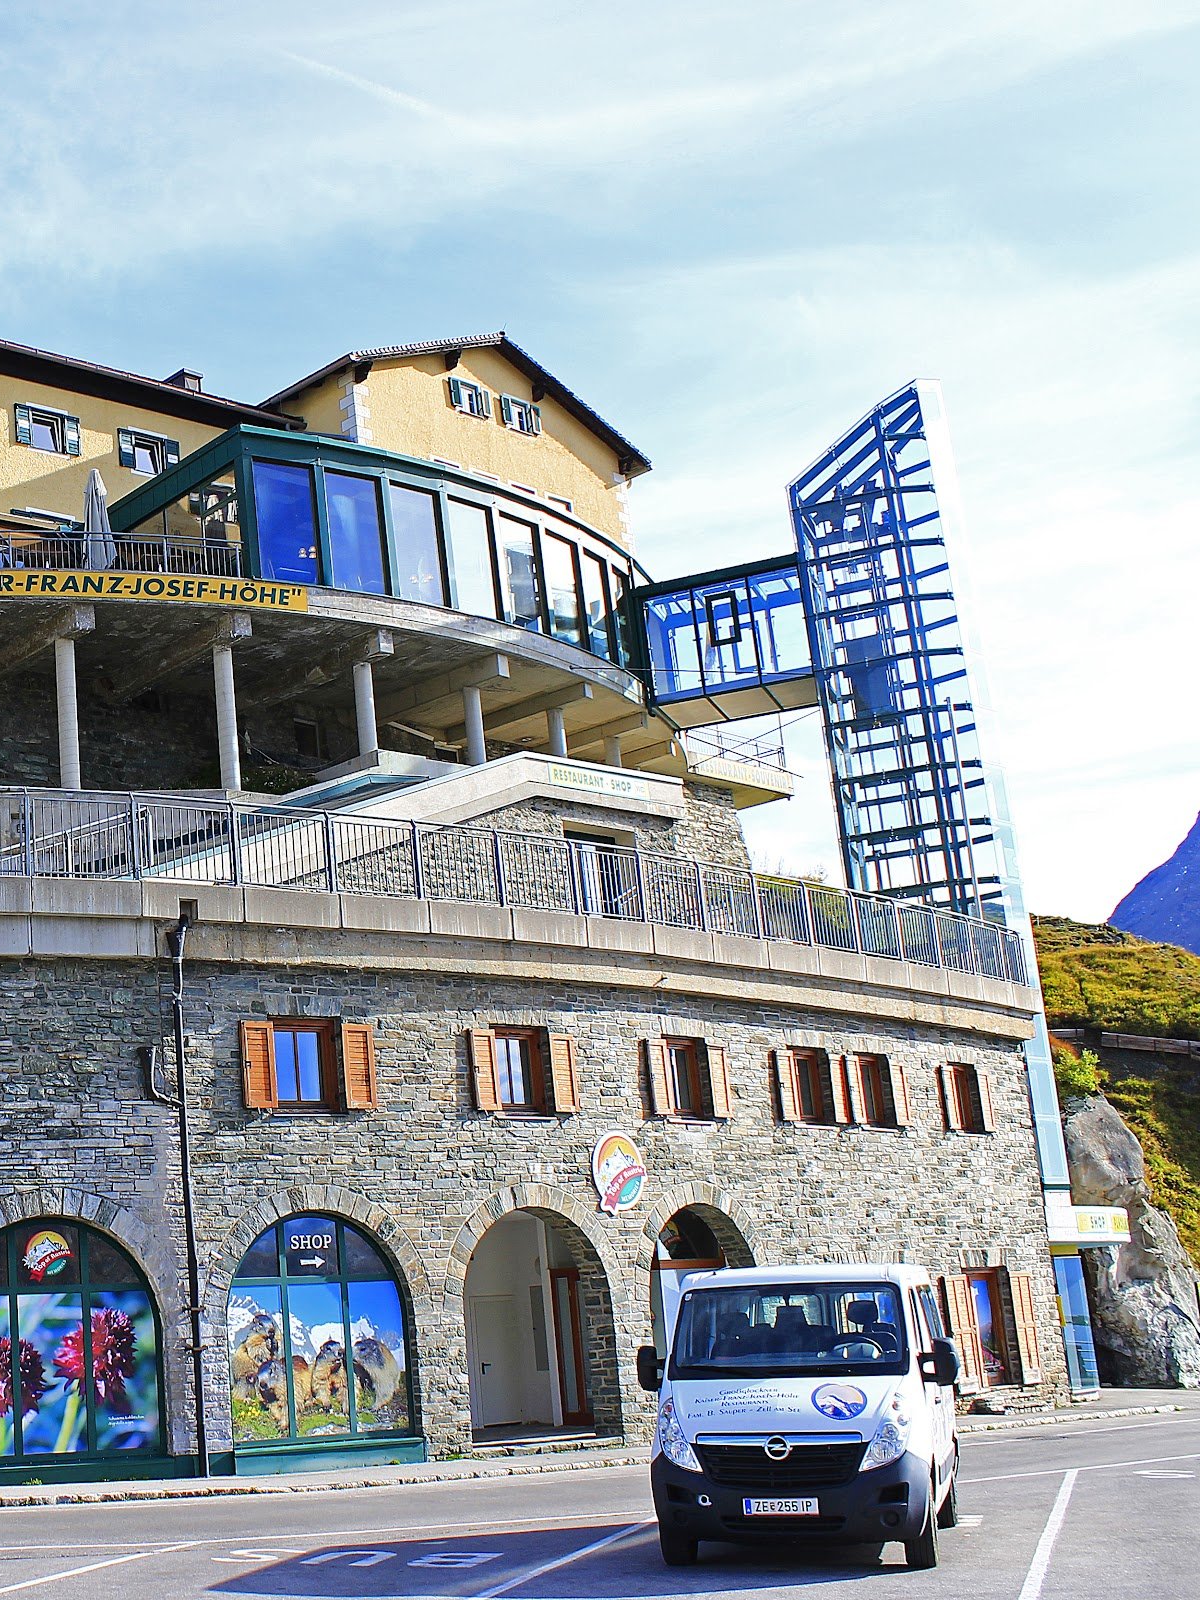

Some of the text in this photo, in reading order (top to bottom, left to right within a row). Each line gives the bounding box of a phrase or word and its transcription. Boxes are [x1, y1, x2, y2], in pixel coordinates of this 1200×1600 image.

[553, 768, 604, 788] RESTAURANT
[611, 779, 632, 793] SHOP
[606, 1167, 643, 1196] Top of Austria
[1090, 1215, 1106, 1229] SHOP
[290, 1234, 332, 1250] SHOP
[33, 1261, 46, 1272] Top
[754, 1500, 812, 1512] ZE 255 IP
[211, 1548, 504, 1569] BUS
